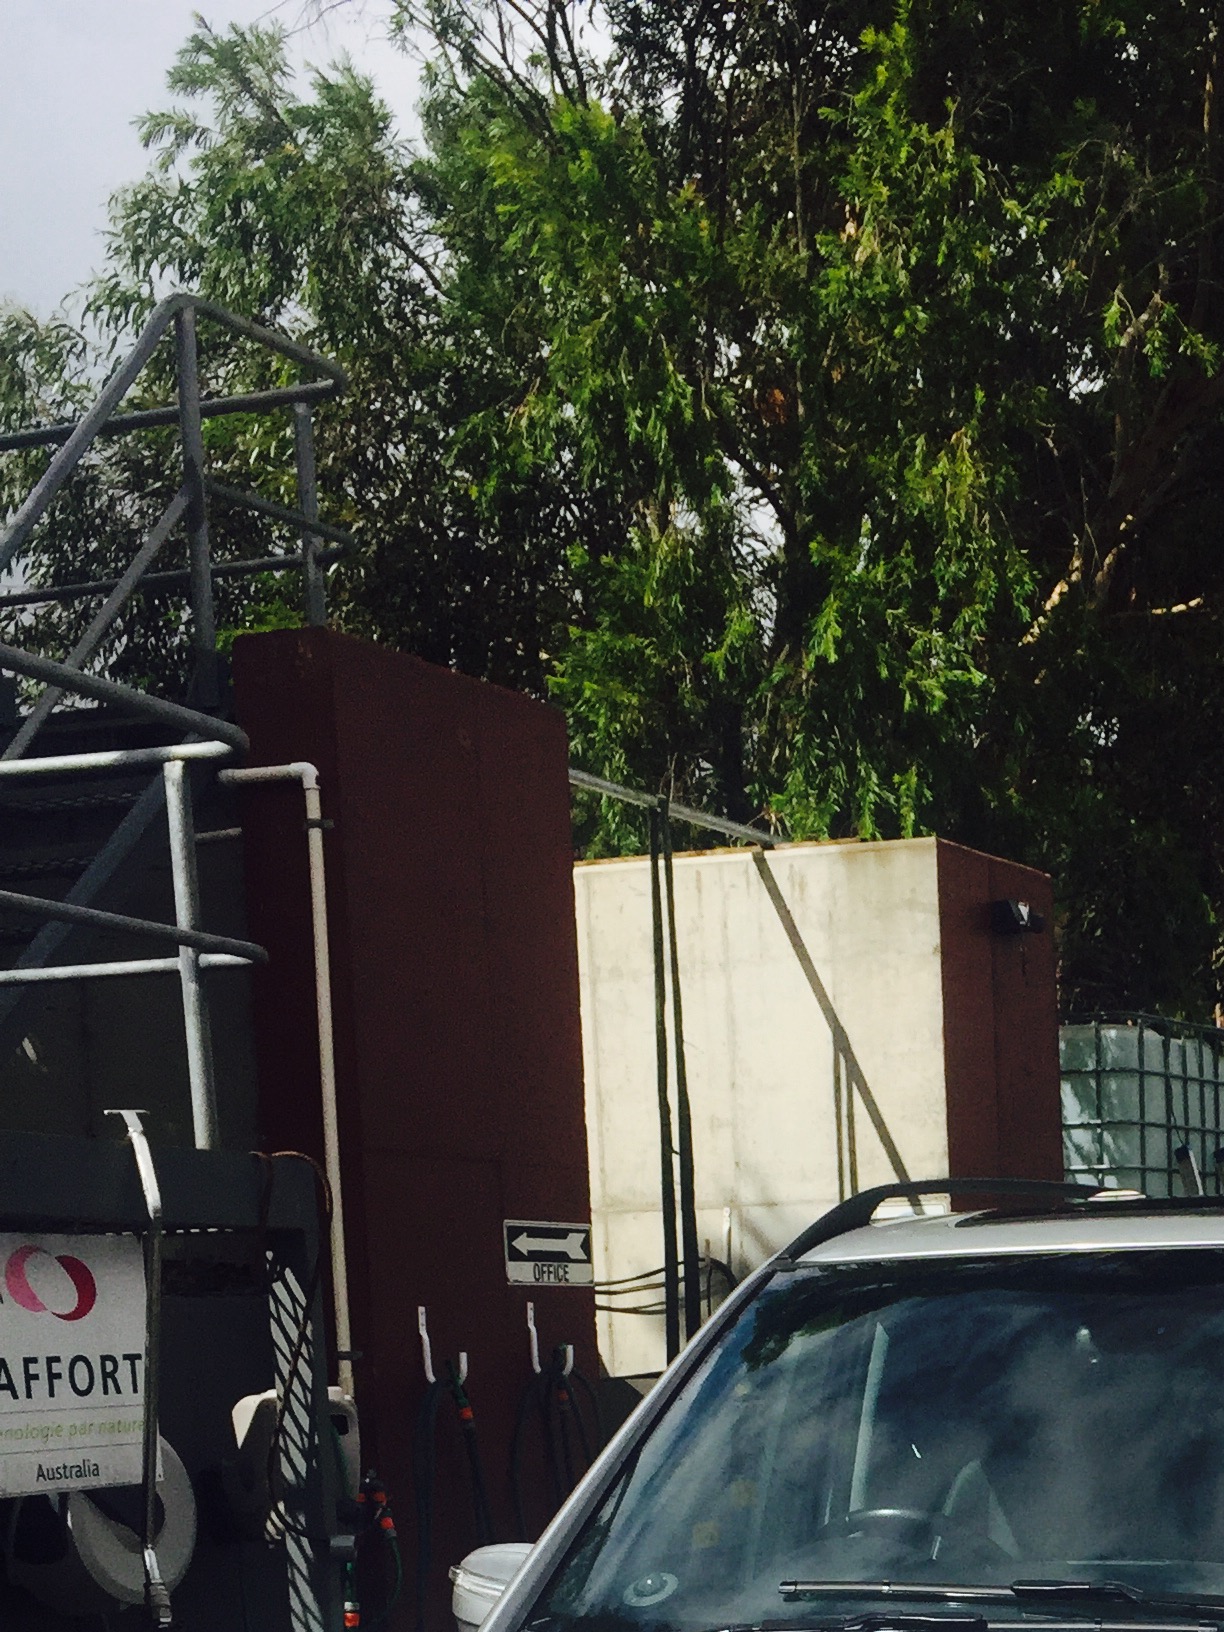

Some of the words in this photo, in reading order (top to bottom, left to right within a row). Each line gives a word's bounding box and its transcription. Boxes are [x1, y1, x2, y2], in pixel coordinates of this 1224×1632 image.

[533, 1263, 569, 1282] OFFICE
[0, 1423, 64, 1444] nologie
[36, 1459, 100, 1482] Australia
